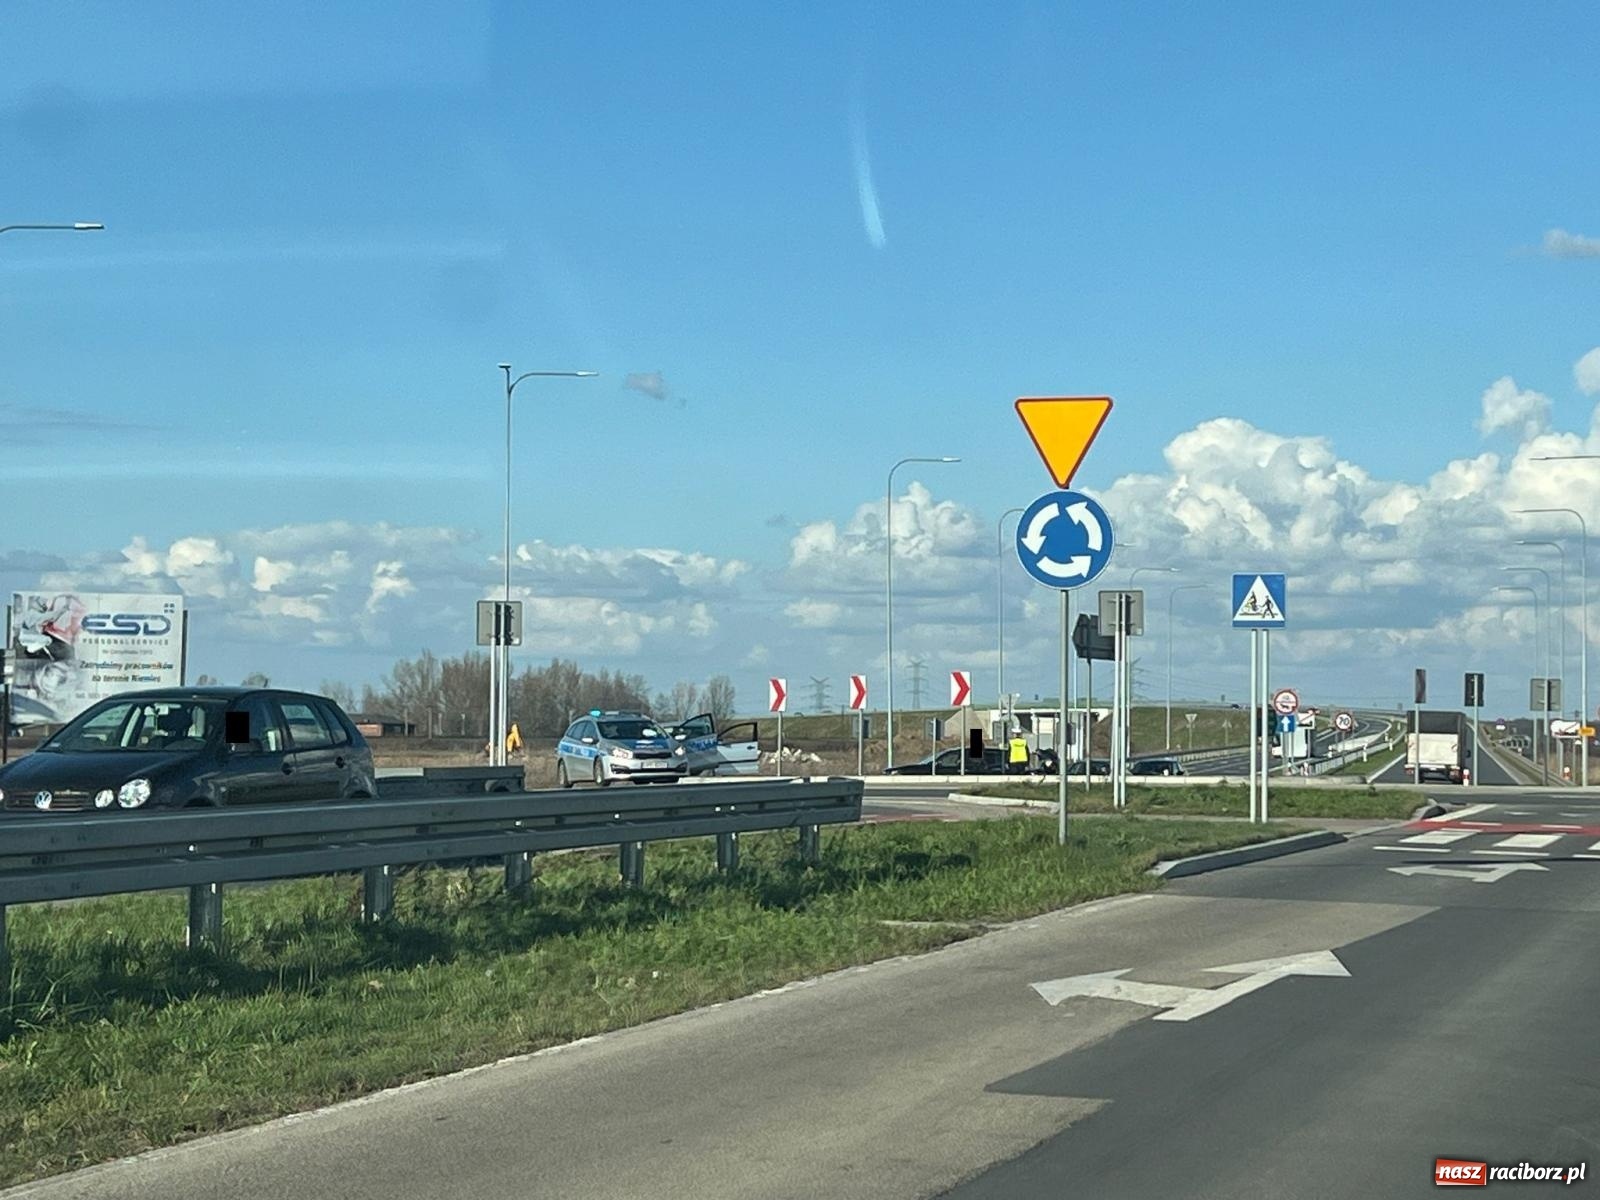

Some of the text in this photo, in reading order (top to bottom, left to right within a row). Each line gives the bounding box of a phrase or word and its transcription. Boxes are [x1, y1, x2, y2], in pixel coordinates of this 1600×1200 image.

[81, 614, 171, 635] ESD
[124, 661, 173, 671] pracowników
[1338, 716, 1350, 726] 70
